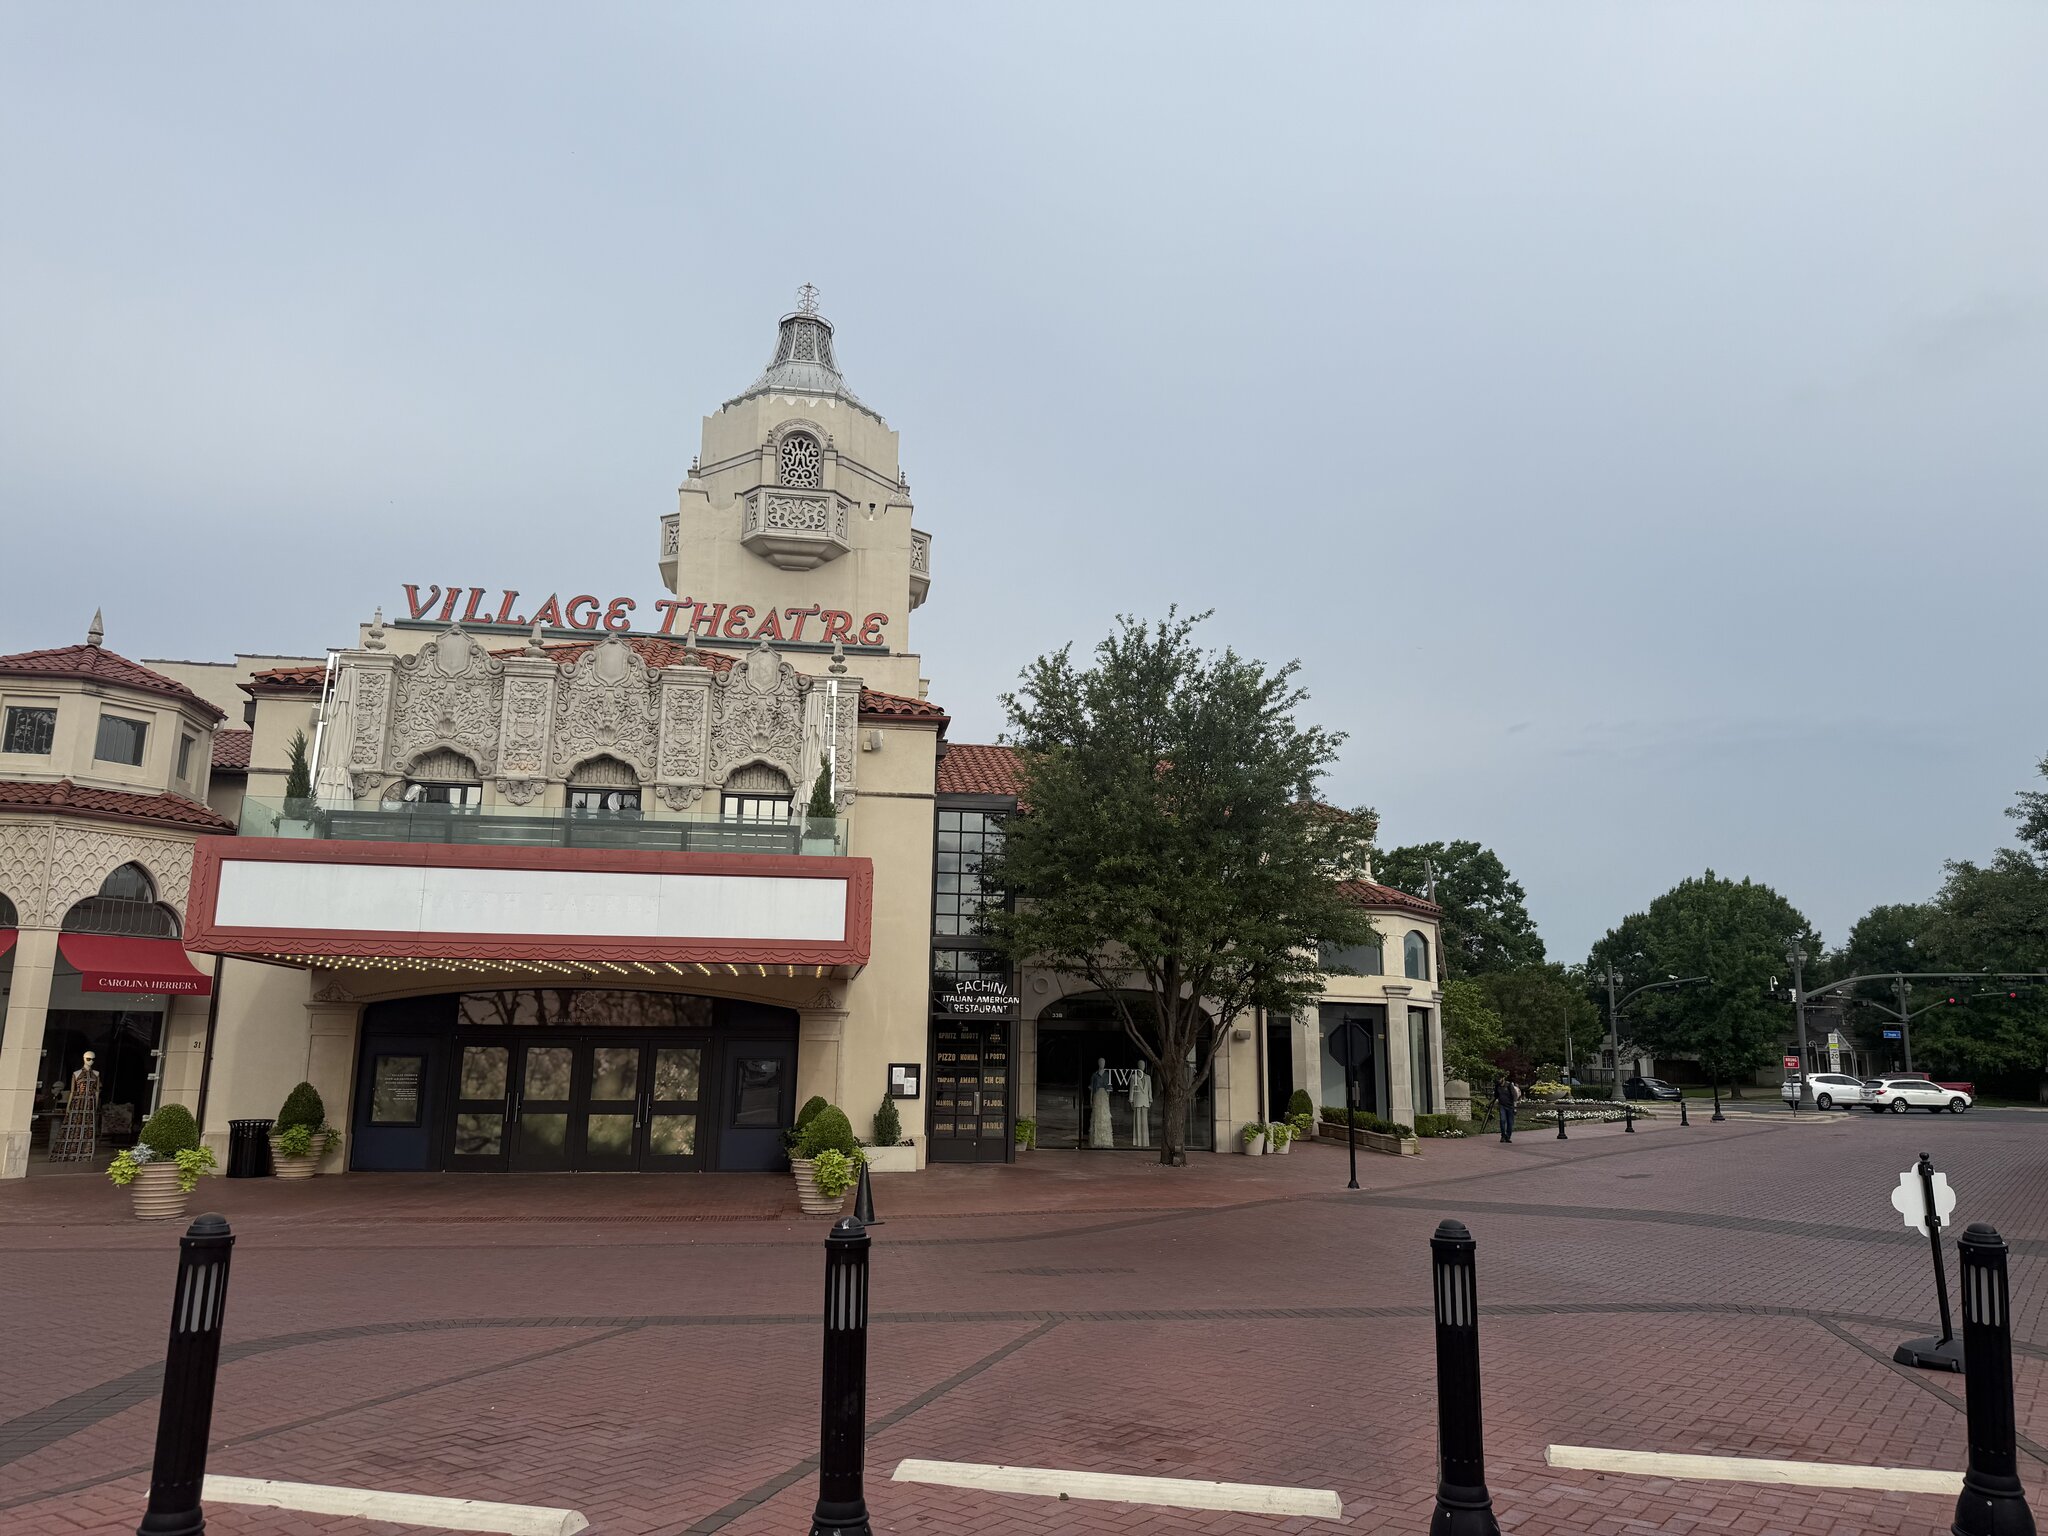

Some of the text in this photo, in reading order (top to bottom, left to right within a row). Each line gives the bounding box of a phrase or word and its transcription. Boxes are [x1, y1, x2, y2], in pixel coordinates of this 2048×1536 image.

[402, 584, 888, 645] VILLAGE THEATRE
[98, 978, 198, 990] CAROLINA HERRERA
[956, 980, 1008, 996] FACHINI
[953, 1003, 1008, 1014] RESTAURANT
[1104, 1068, 1144, 1086] TWP
